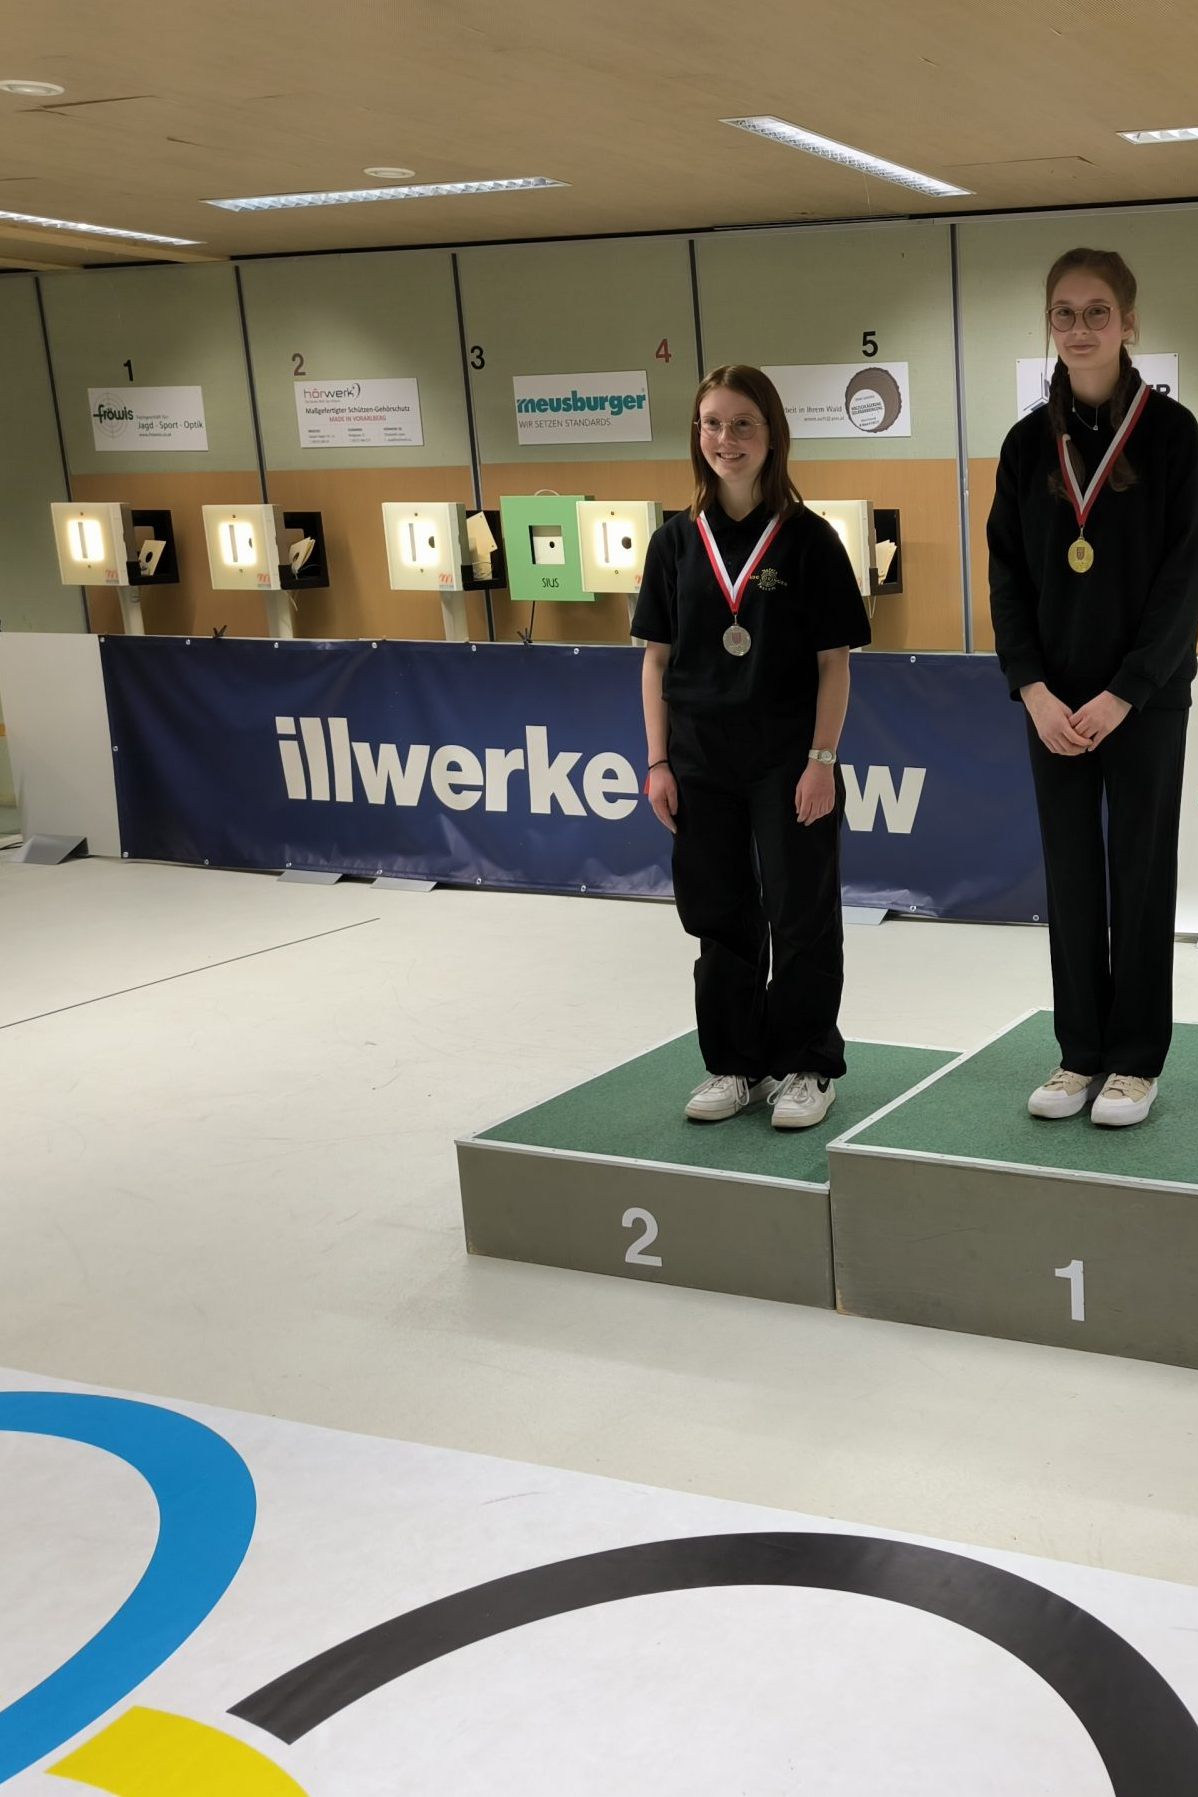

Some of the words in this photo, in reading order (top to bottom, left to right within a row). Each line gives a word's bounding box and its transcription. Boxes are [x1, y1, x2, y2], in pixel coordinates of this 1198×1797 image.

[655, 338, 672, 363] 4
[862, 331, 878, 357] 5
[123, 359, 133, 381] 1
[292, 353, 306, 376] 2
[470, 345, 486, 370] 3
[93, 404, 134, 423] fröwis
[517, 390, 646, 416] meusburger
[138, 421, 154, 431] Jagd
[159, 421, 179, 430] Sport
[184, 420, 203, 430] Optik
[519, 419, 533, 429] WIR
[535, 418, 563, 428] SETZEN
[564, 417, 611, 427] STANDARDS
[541, 577, 559, 588] SIUS
[275, 716, 639, 820] illwerke
[621, 1207, 662, 1267] 2
[1054, 1259, 1085, 1322] 1
